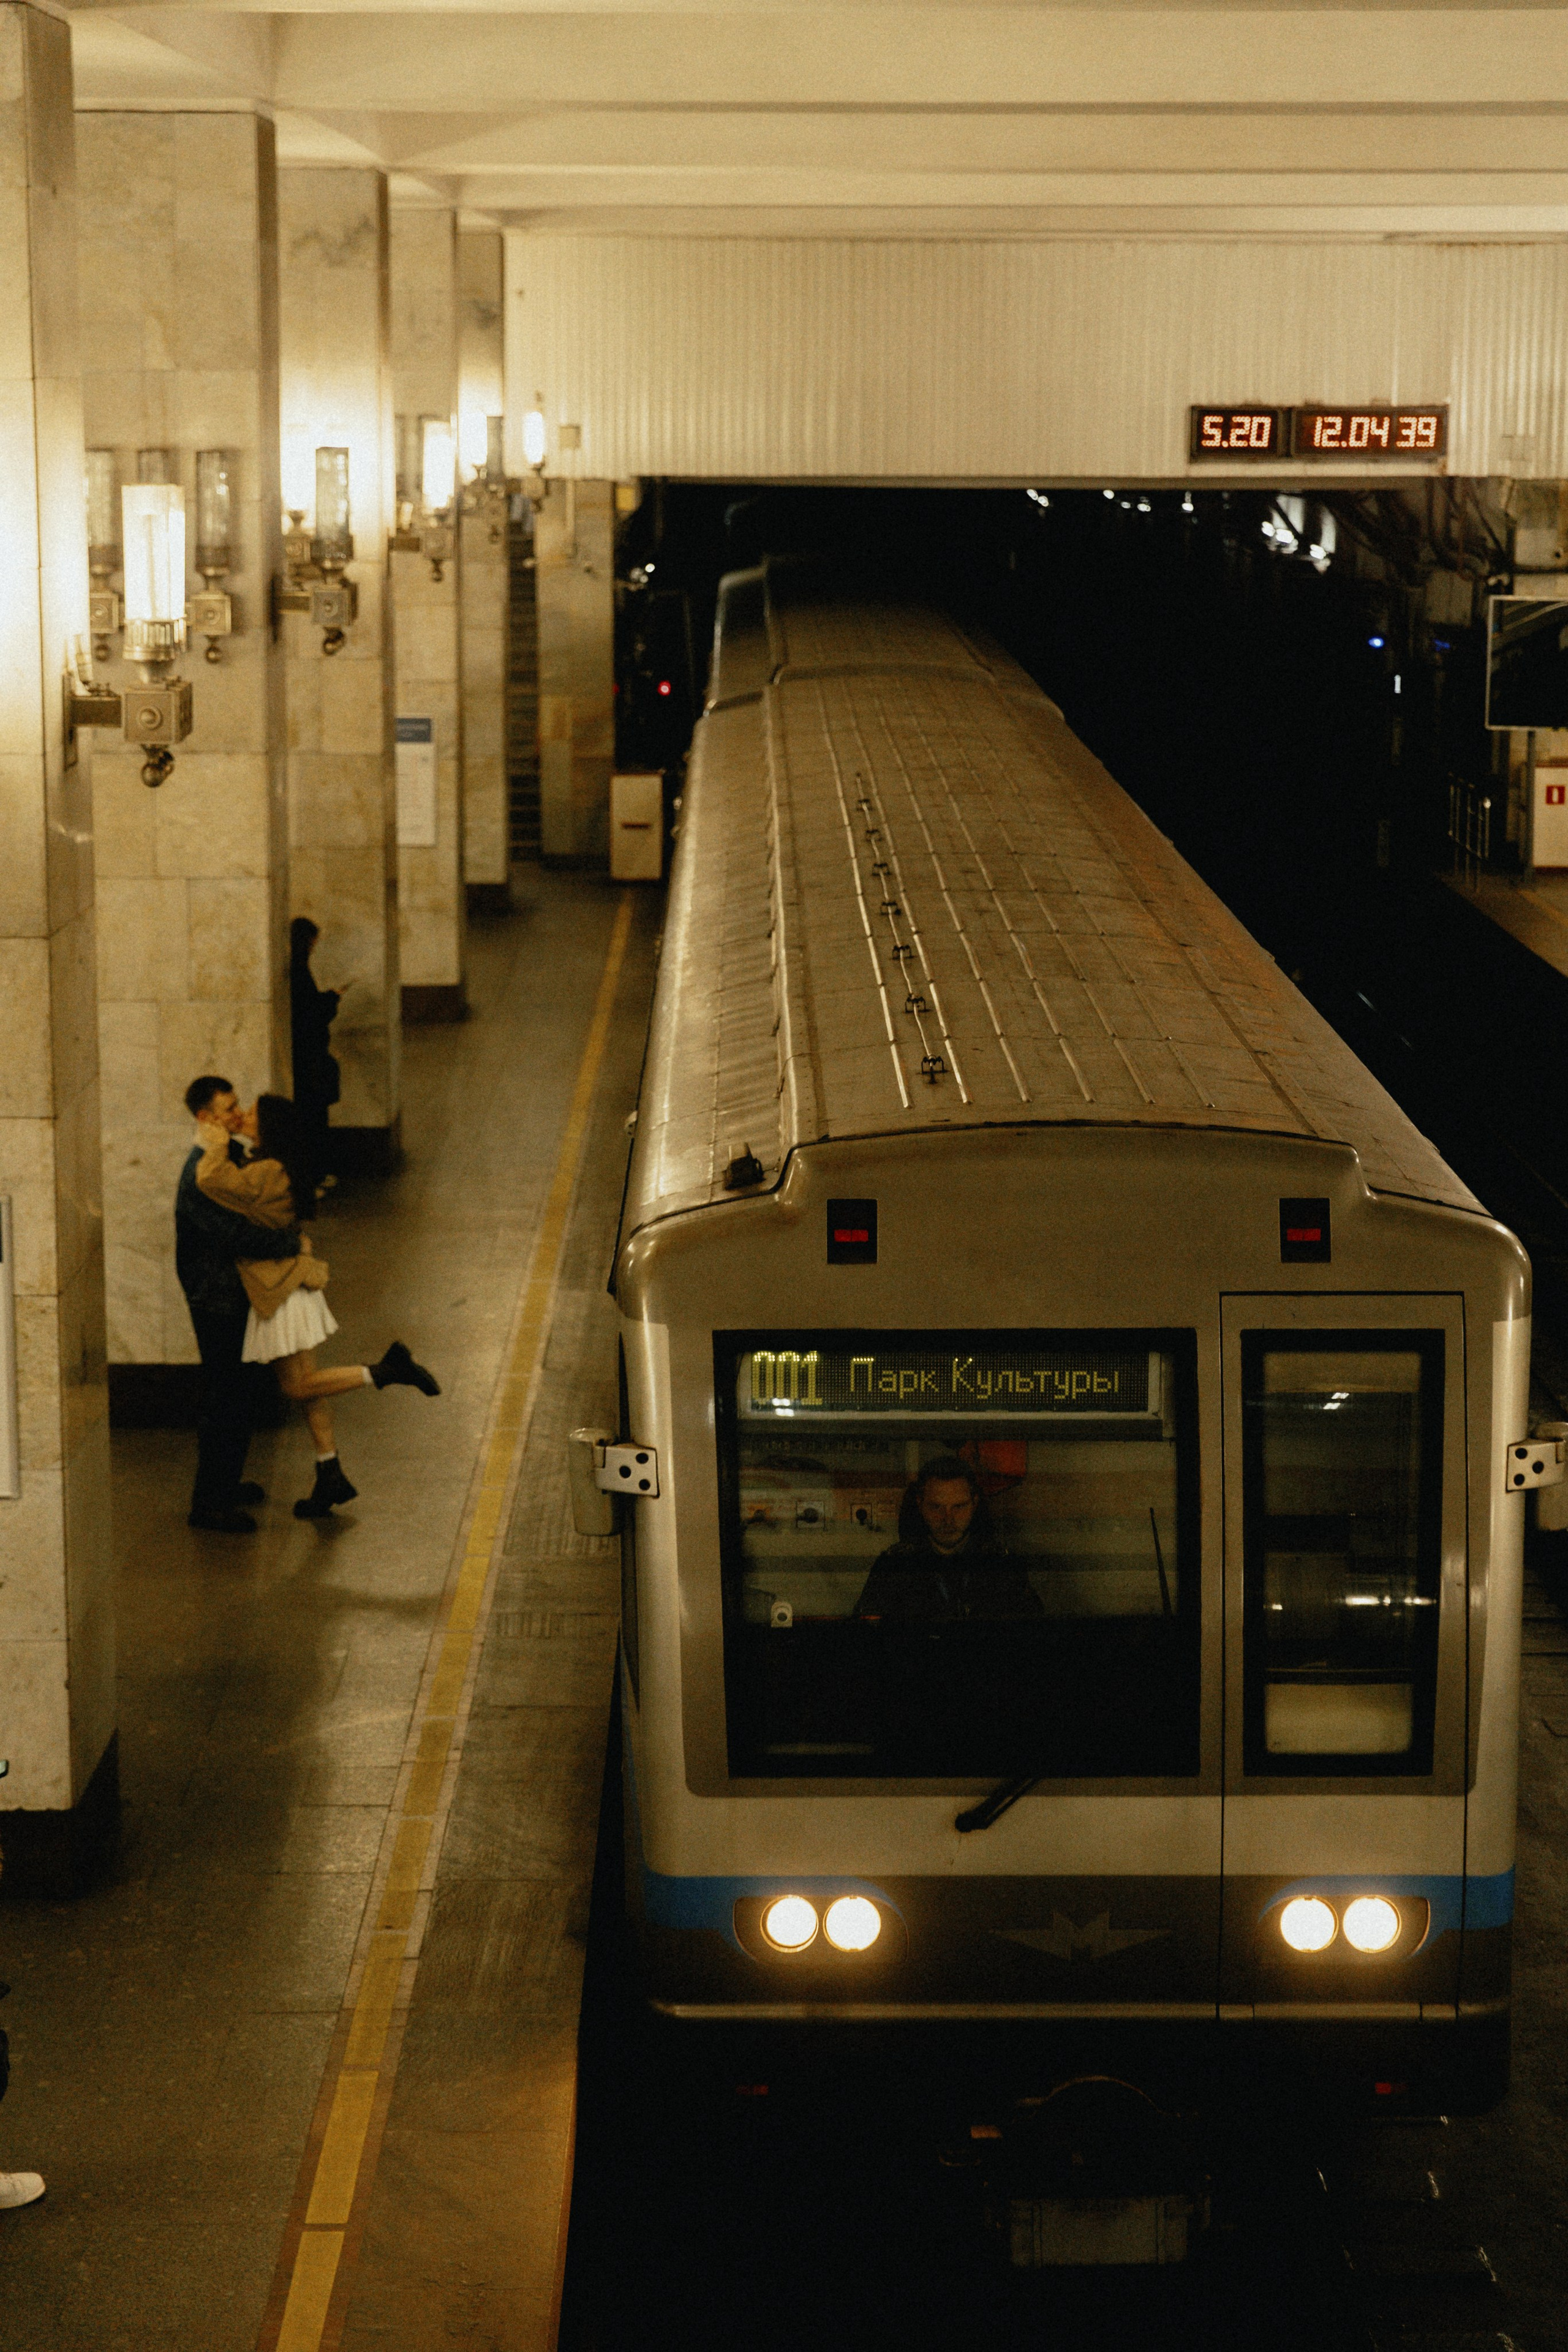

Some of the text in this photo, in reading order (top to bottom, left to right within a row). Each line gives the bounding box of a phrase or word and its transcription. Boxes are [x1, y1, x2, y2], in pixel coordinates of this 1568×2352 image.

[1202, 417, 1272, 448] 5.20
[752, 1351, 1119, 1405] 001 Парк Культуры
